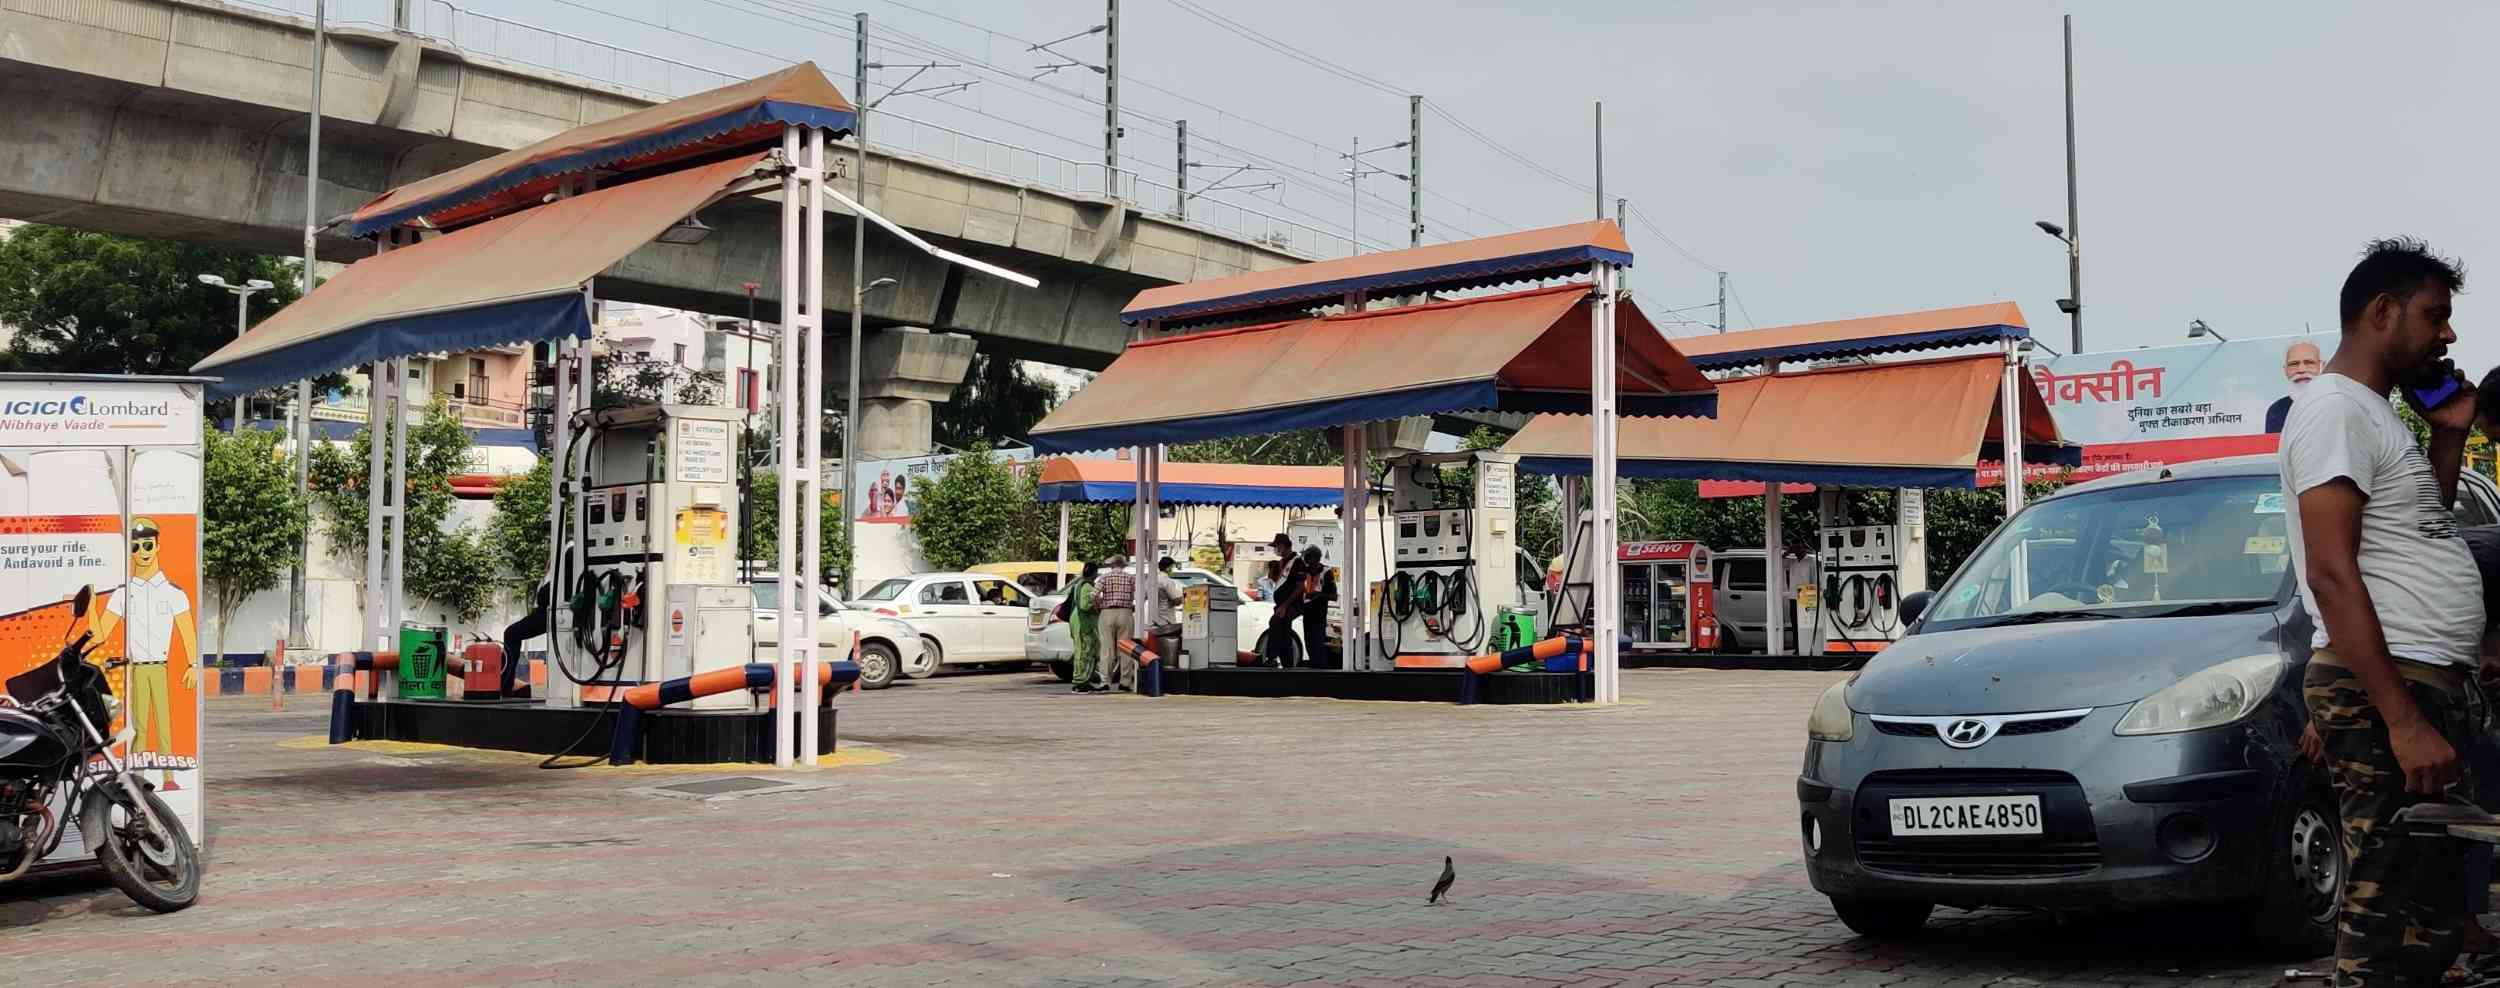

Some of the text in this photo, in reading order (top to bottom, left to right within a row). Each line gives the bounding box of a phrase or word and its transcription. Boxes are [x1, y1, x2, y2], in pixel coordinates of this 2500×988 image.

[4, 400, 169, 416] ICICI Lombard
[2127, 405, 2154, 421] दुनिया
[2155, 406, 2169, 417] का
[2195, 402, 2212, 416] बड़ा
[0, 418, 105, 433] Nibhaye Vaade
[2160, 413, 2205, 429] टीकाकरण
[2207, 411, 2243, 425] अभियान
[30, 544, 59, 556] your
[1641, 543, 1682, 553] SERVO
[67, 558, 74, 568] a
[1903, 803, 2038, 829] DL2CAE4850
